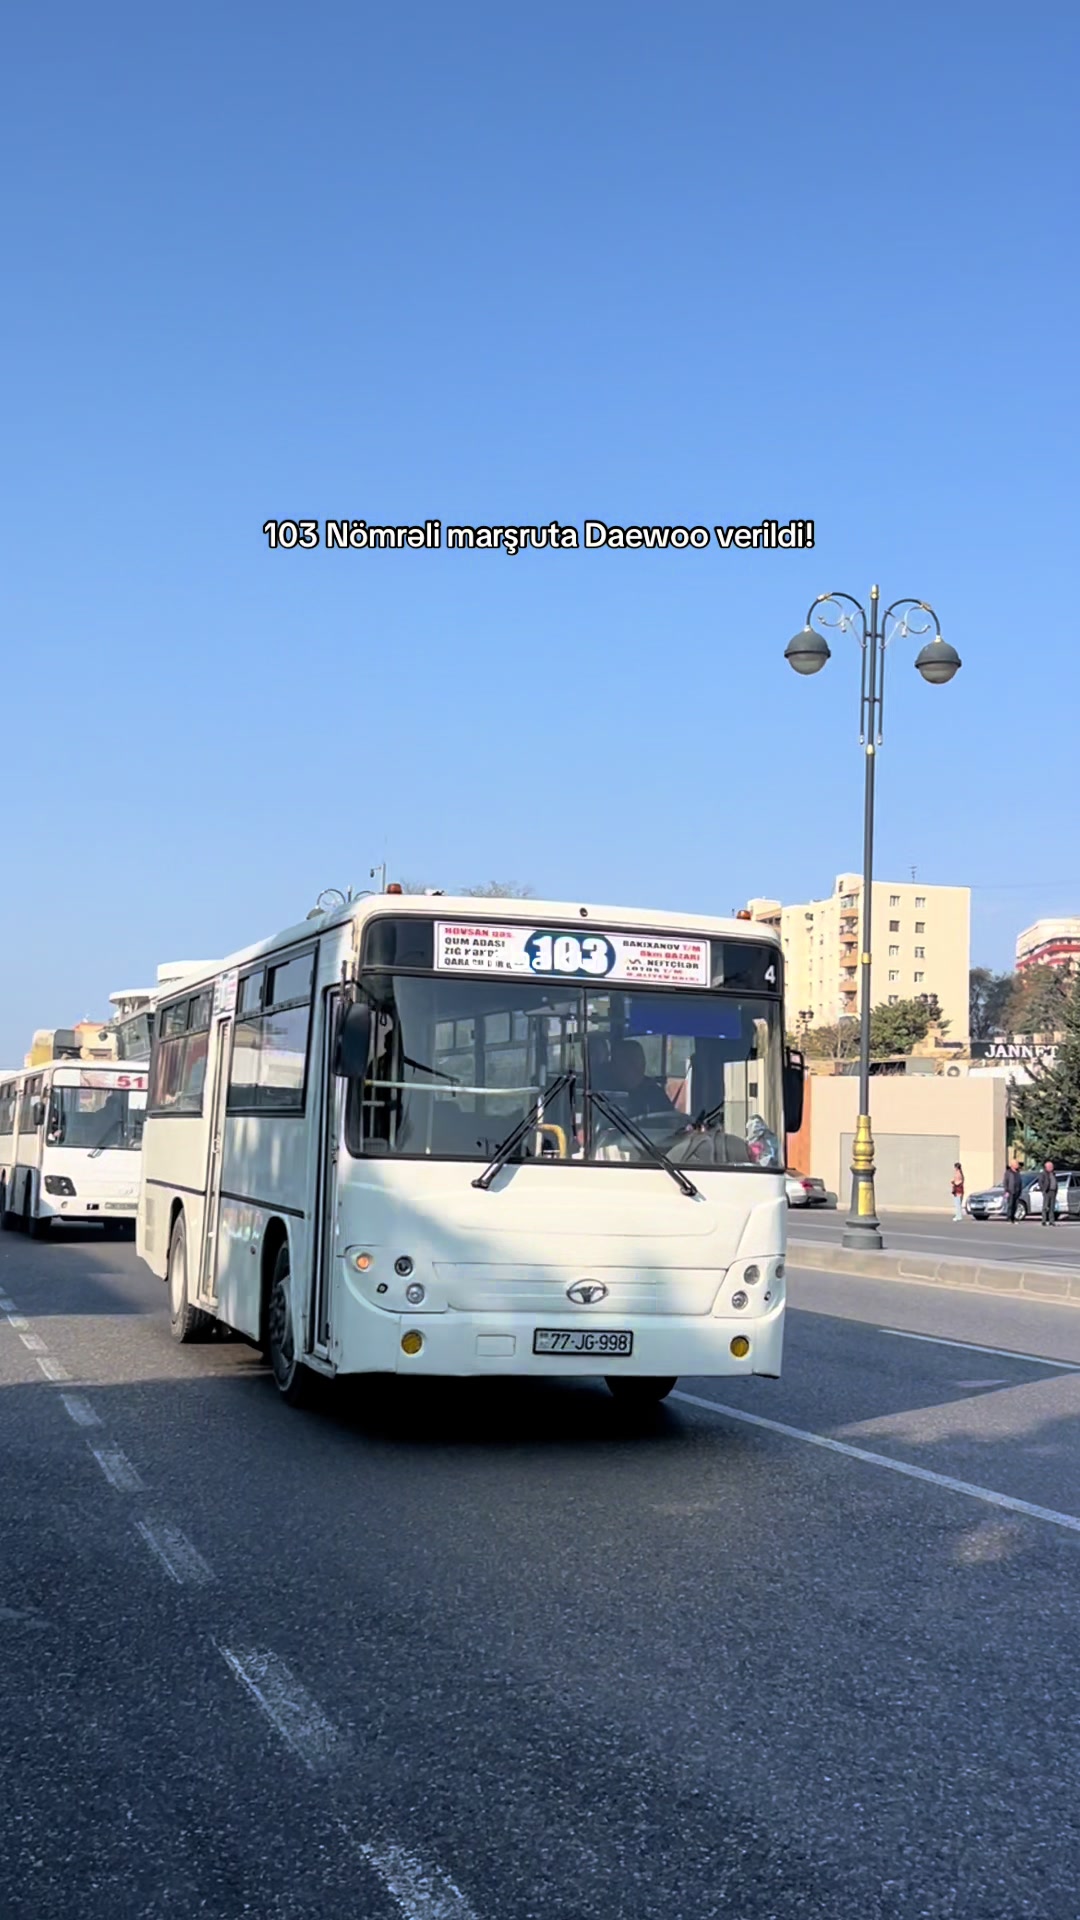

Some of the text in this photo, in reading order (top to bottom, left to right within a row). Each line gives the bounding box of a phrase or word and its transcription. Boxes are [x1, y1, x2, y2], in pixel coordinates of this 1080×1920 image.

[532, 935, 609, 975] 103
[764, 964, 776, 984] 4
[117, 1075, 144, 1089] 51
[551, 1333, 628, 1351] 77-JG-998
